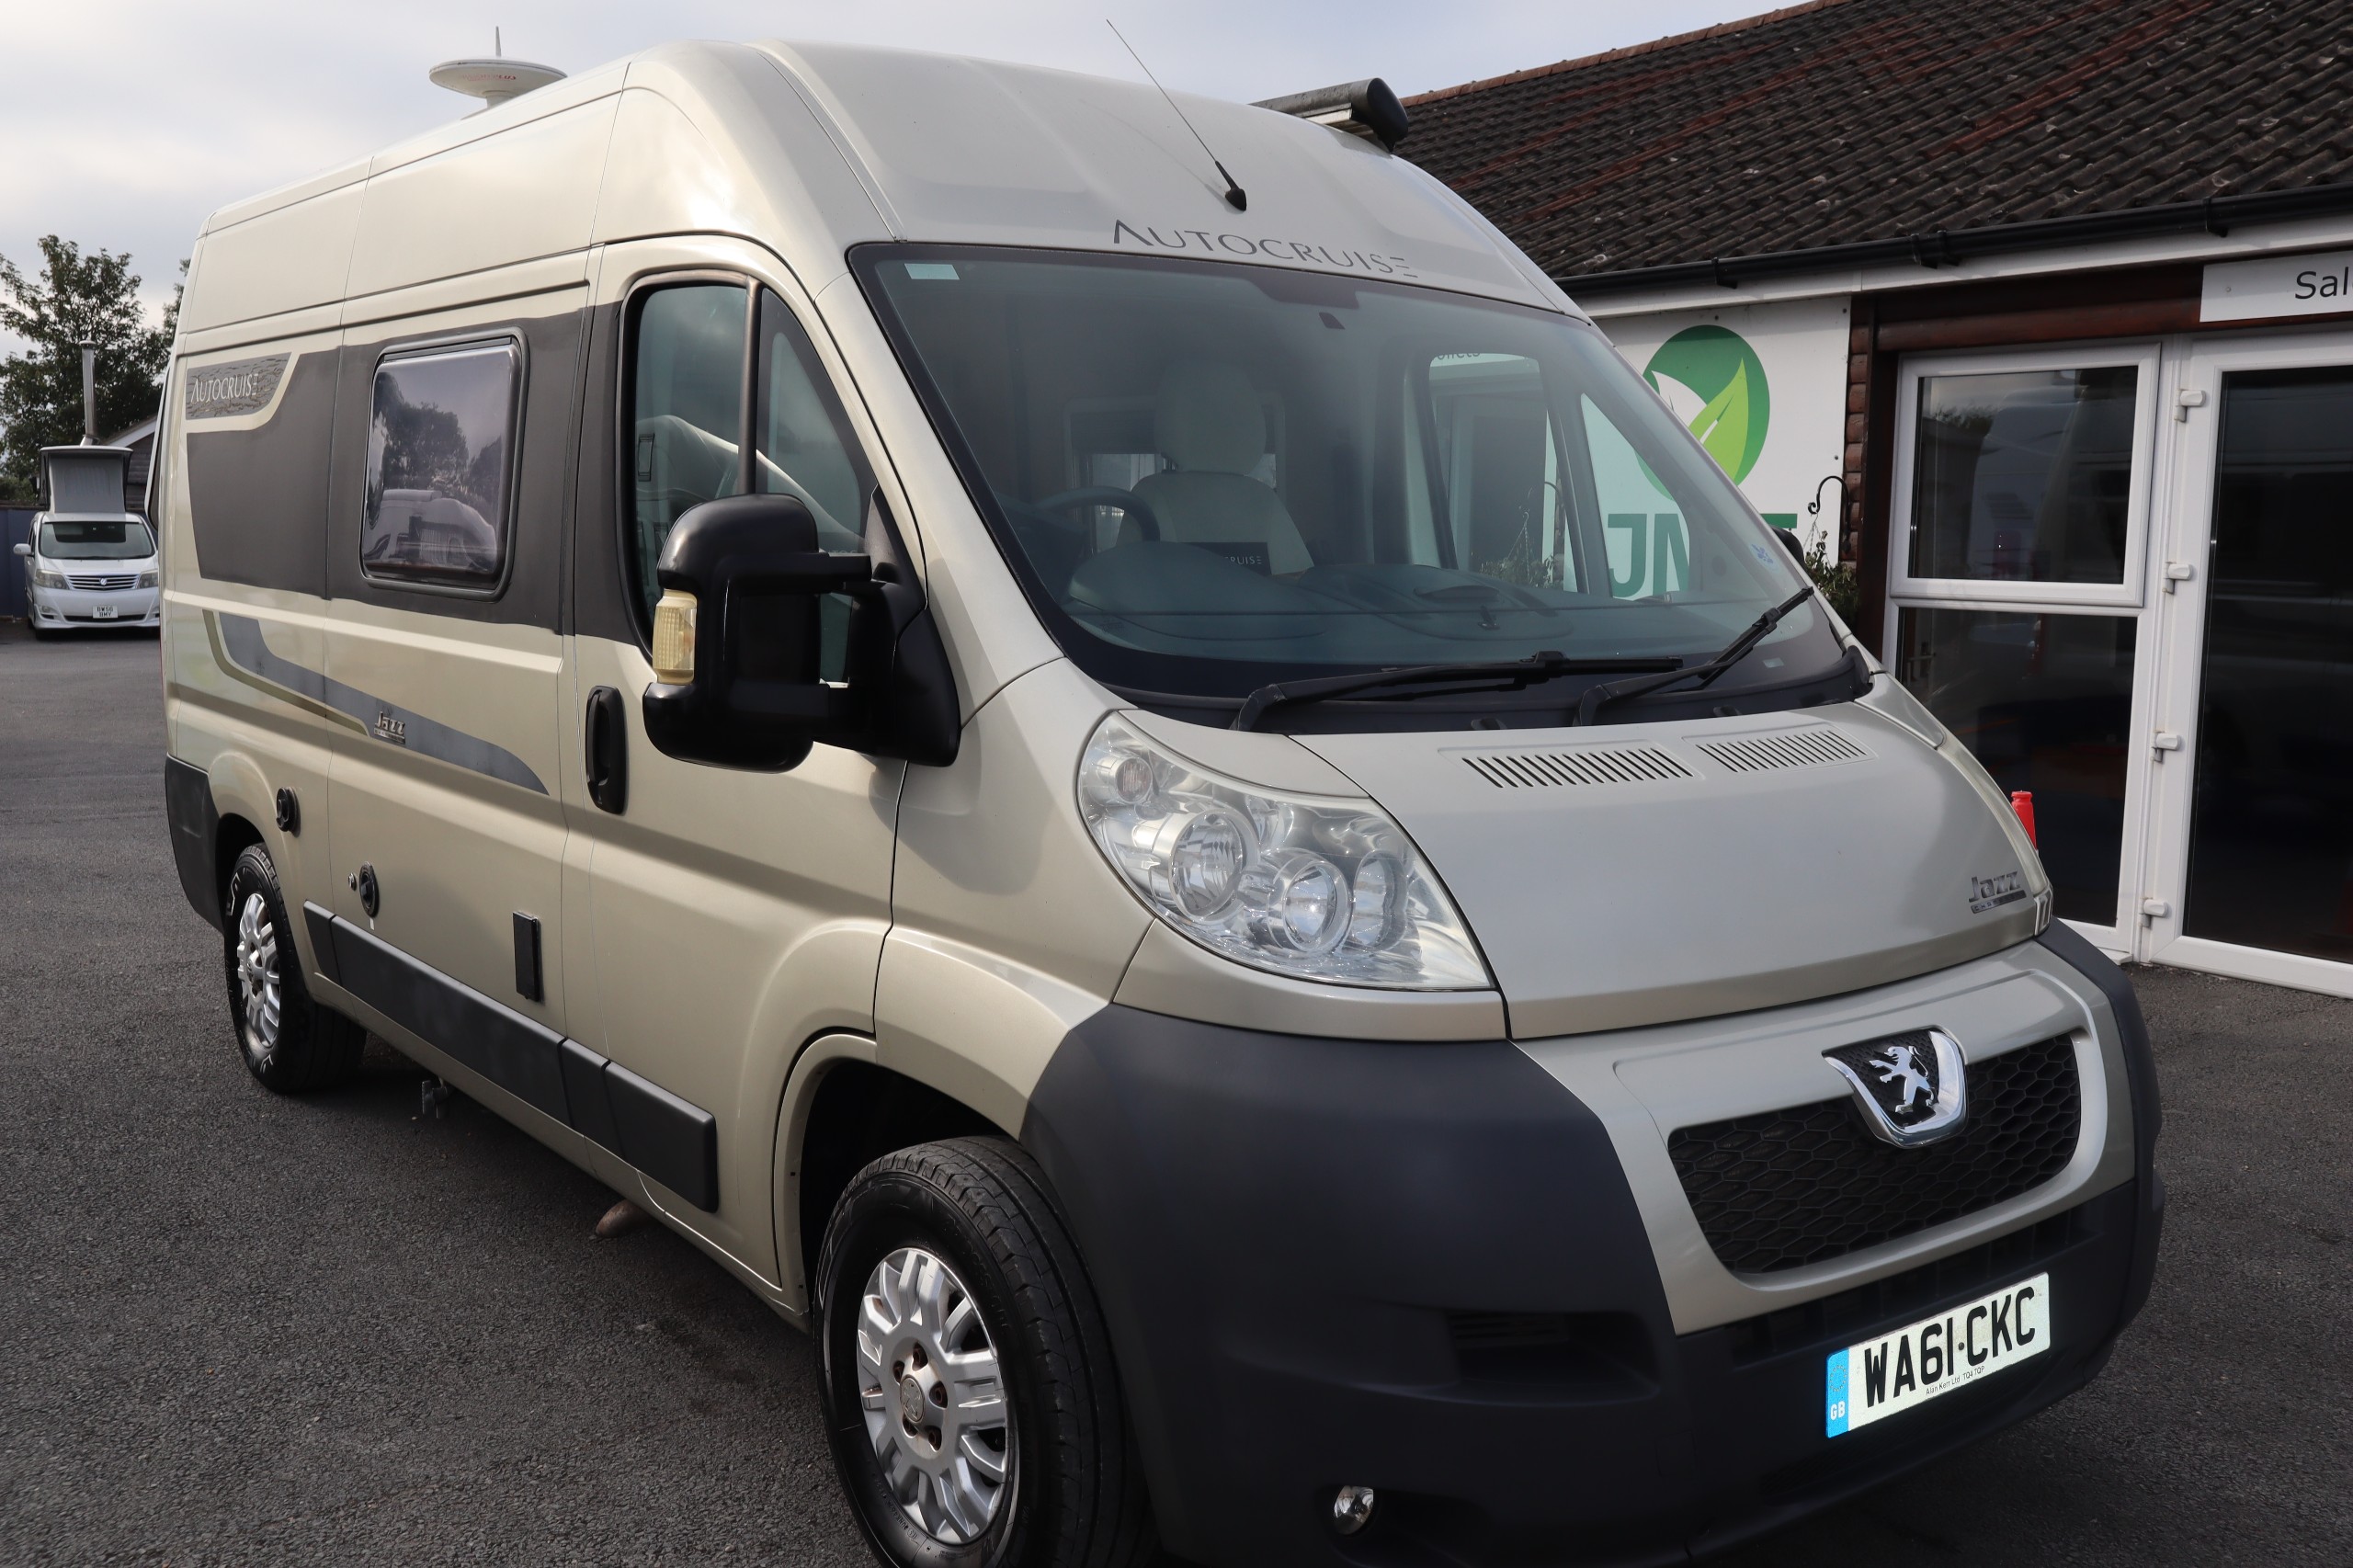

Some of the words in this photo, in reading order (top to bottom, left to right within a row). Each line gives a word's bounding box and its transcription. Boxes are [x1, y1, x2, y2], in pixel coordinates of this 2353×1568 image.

[1113, 219, 1419, 278] AUTOCRUISE
[2294, 266, 2353, 300] Sal
[190, 373, 259, 403] AUTOCRUISE
[375, 710, 405, 735] Jazz
[1968, 870, 2020, 903] Jazz
[1926, 1386, 1938, 1396] Alan
[1938, 1380, 1950, 1391] Kerr
[1951, 1375, 1961, 1385] Ltd
[1830, 1401, 1846, 1421] GB
